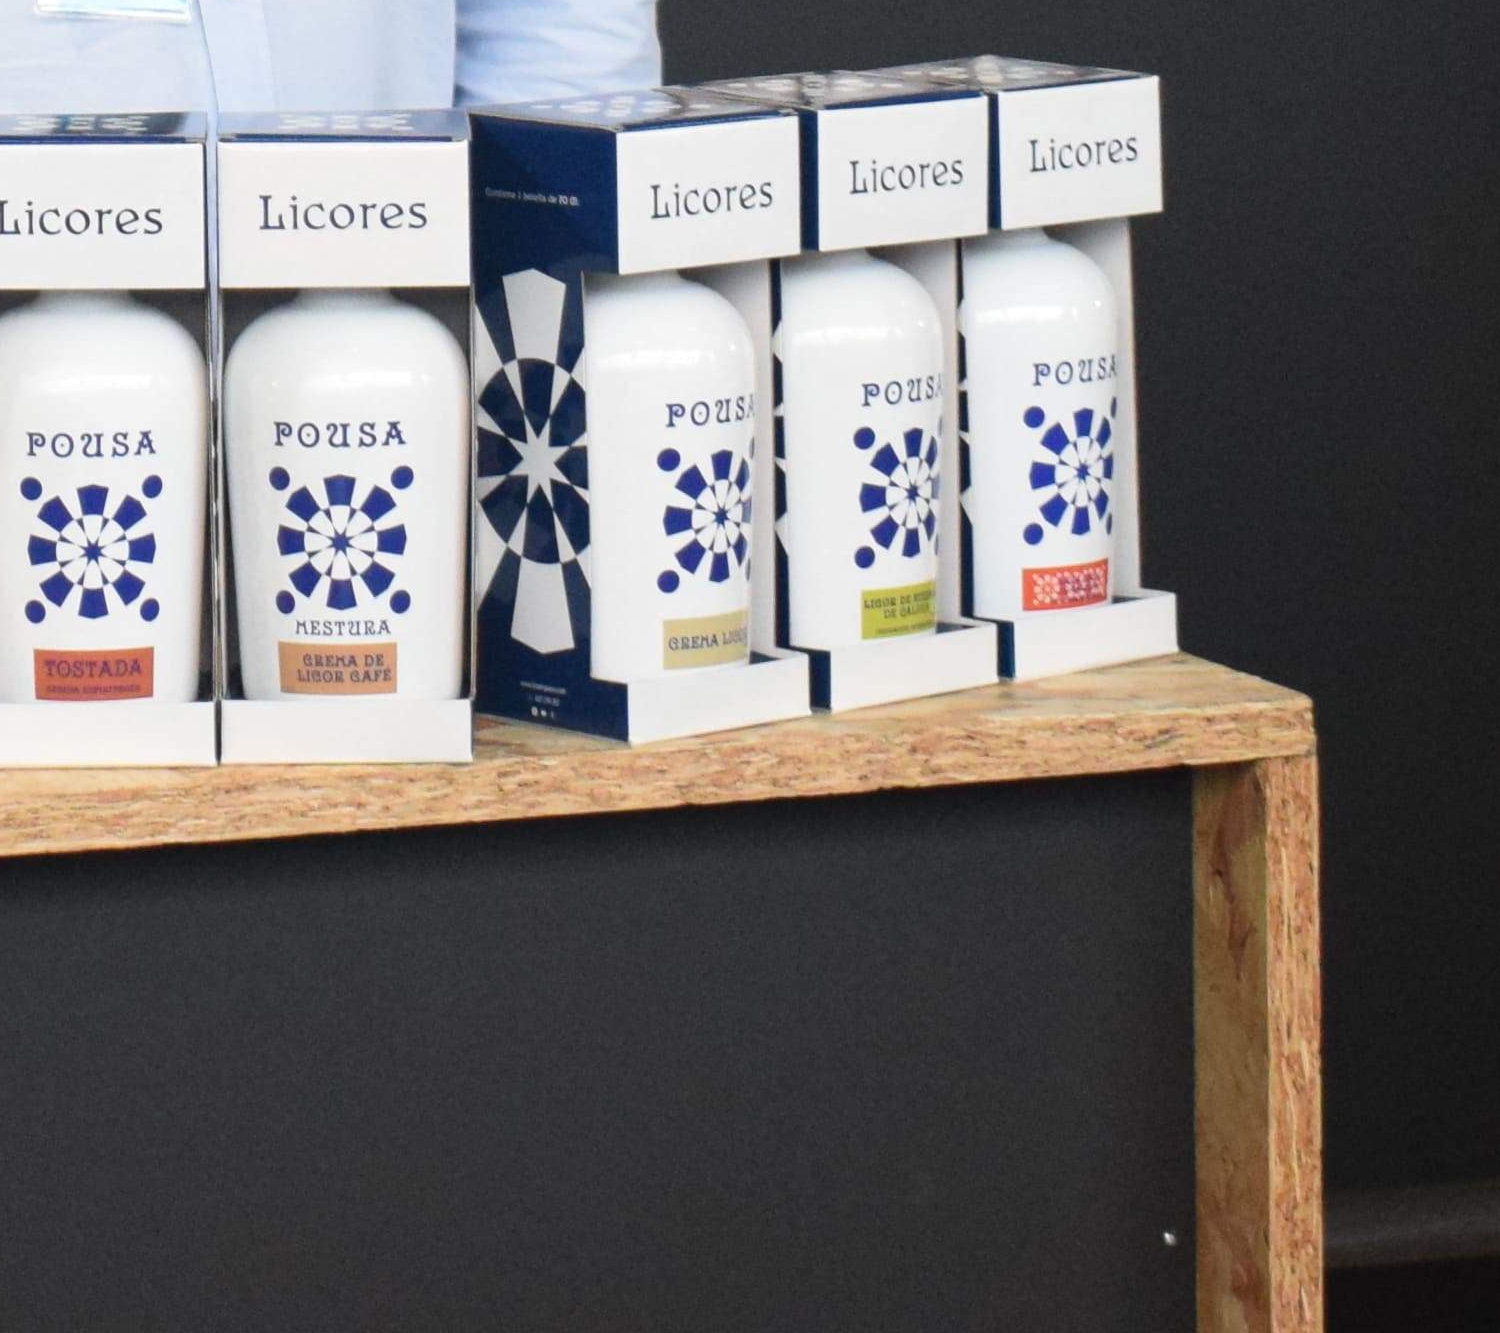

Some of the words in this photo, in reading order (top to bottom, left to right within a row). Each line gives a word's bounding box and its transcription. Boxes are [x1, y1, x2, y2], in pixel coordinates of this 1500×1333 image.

[1028, 136, 1138, 173] Licores
[849, 159, 964, 196] Licores
[259, 194, 427, 231] Licores
[651, 181, 773, 220] Licores
[1032, 354, 1118, 387] POUSA
[26, 430, 156, 459] POUSA
[273, 421, 407, 449] POUSA
[296, 619, 391, 636] MESTURA
[45, 659, 141, 678] TOSTADA
[303, 654, 358, 667] CREMA
[364, 654, 385, 667] DE
[298, 669, 345, 683] LICOR
